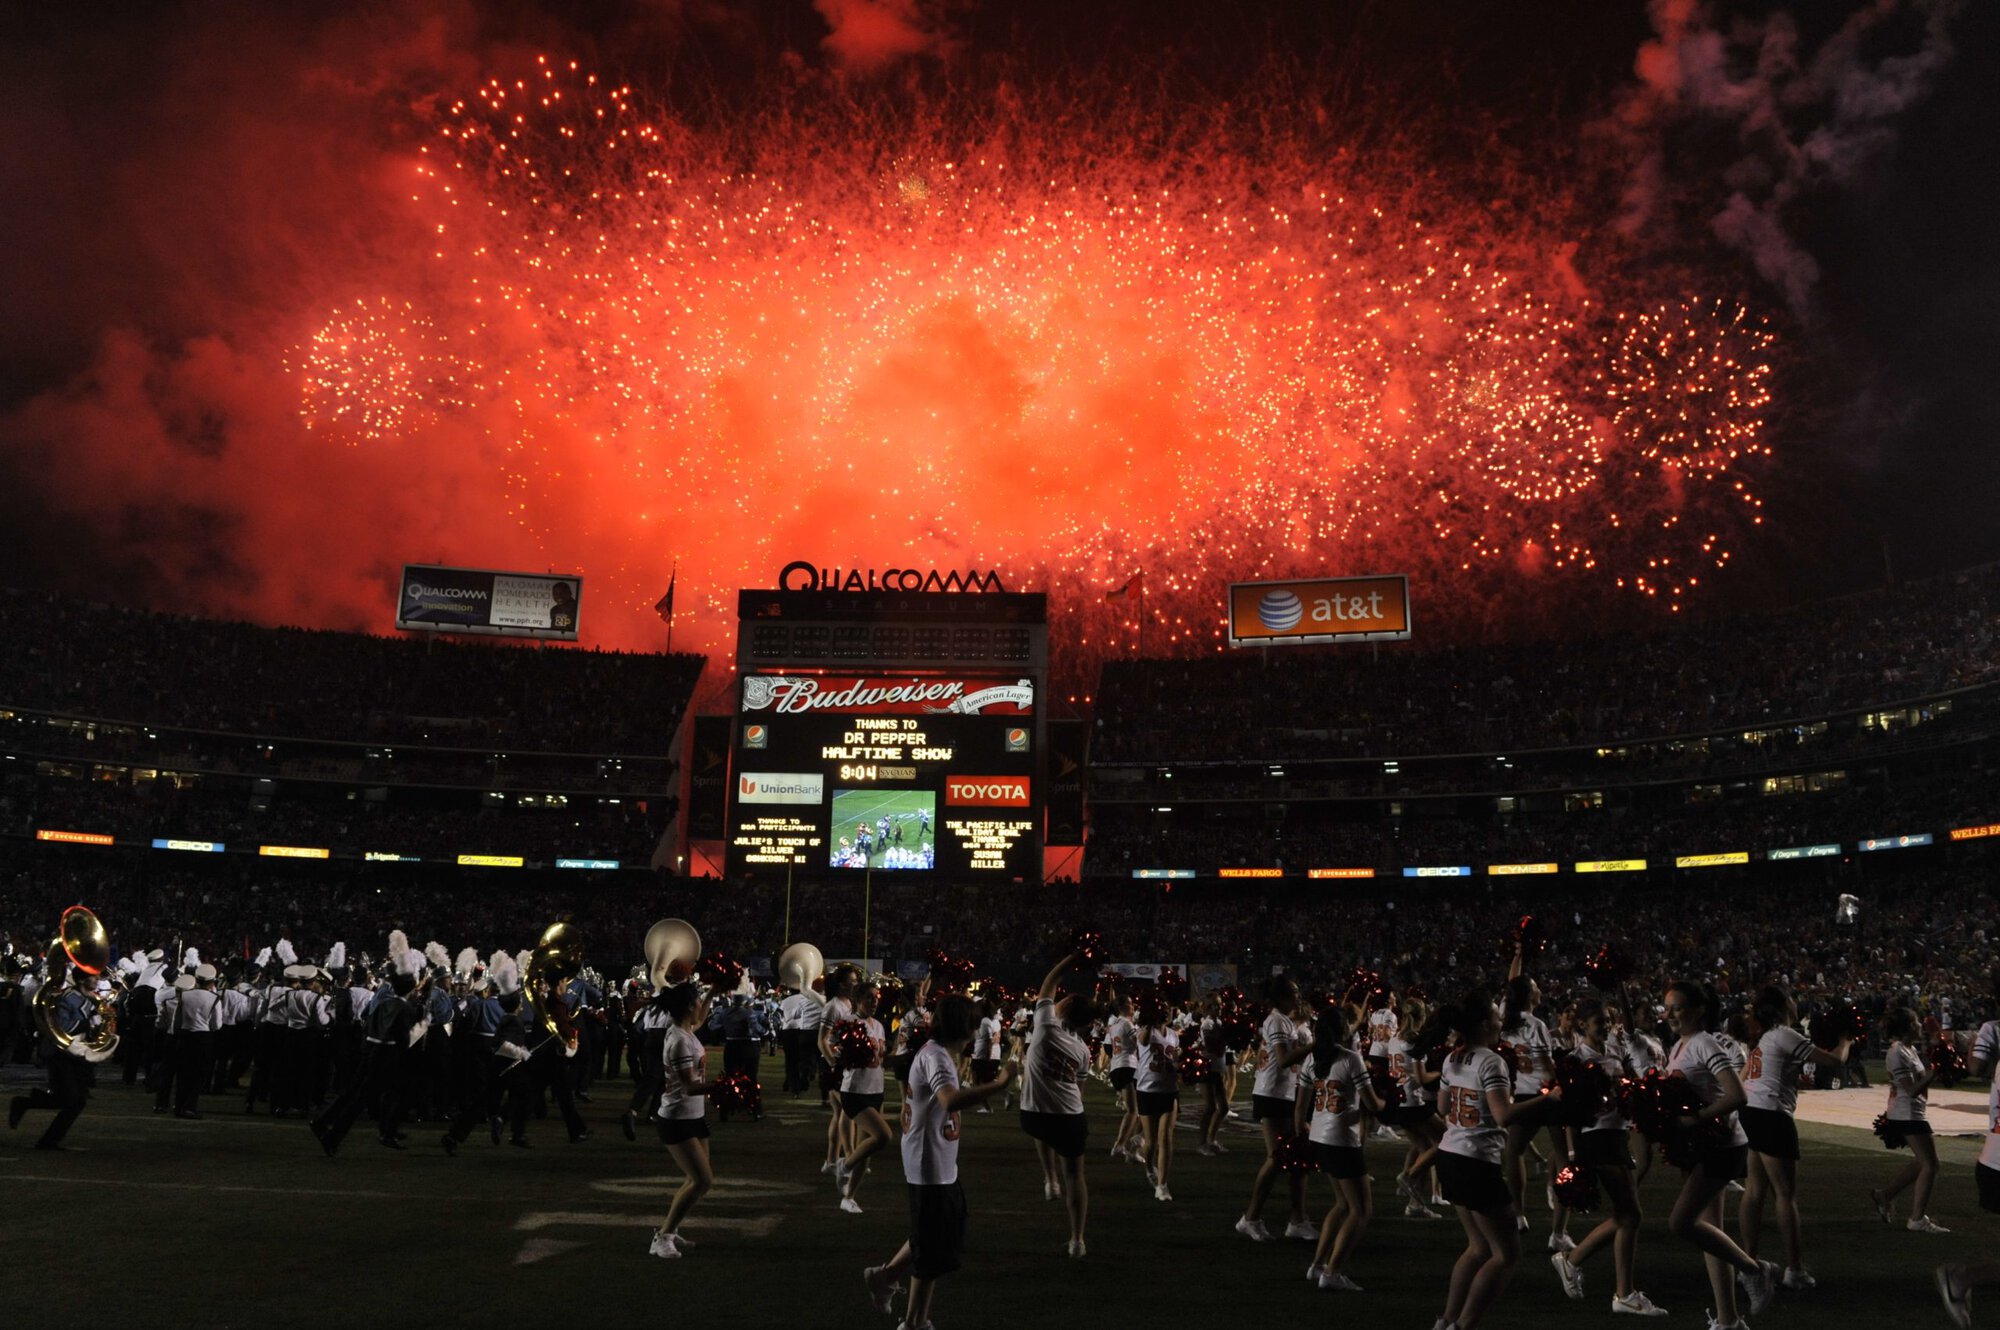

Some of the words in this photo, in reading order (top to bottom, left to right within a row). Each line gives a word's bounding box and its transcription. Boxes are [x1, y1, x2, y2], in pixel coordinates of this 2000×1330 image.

[779, 561, 1004, 592] QUALCOMM
[408, 583, 488, 600] QUALCOMM
[422, 601, 473, 613] innovation
[496, 599, 550, 609] HEALTH
[1311, 591, 1384, 622] at&t
[499, 617, 543, 627] www.pph.org
[768, 678, 963, 713] Budweiser
[966, 691, 1004, 707] American
[1006, 690, 1030, 700] Lager
[856, 719, 898, 730] THANKS
[902, 719, 918, 730] TO
[844, 732, 865, 744] DR
[871, 733, 926, 745] PEPPER
[822, 746, 902, 759] HALFTIME
[911, 748, 953, 760] SHOW
[840, 764, 877, 781] 9:04
[760, 784, 821, 794] UnionBank
[950, 784, 1026, 799] TOYOTA
[946, 821, 963, 829] THE
[966, 821, 1006, 830] PACIFIC
[1008, 822, 1032, 830] LIFE
[1951, 827, 1987, 839] WELLS
[970, 860, 1005, 869] MILLER
[1498, 865, 1548, 874] CYMER
[1220, 869, 1250, 877] WELLS
[1252, 869, 1282, 877] FARGO
[1416, 867, 1460, 876] GEICO
